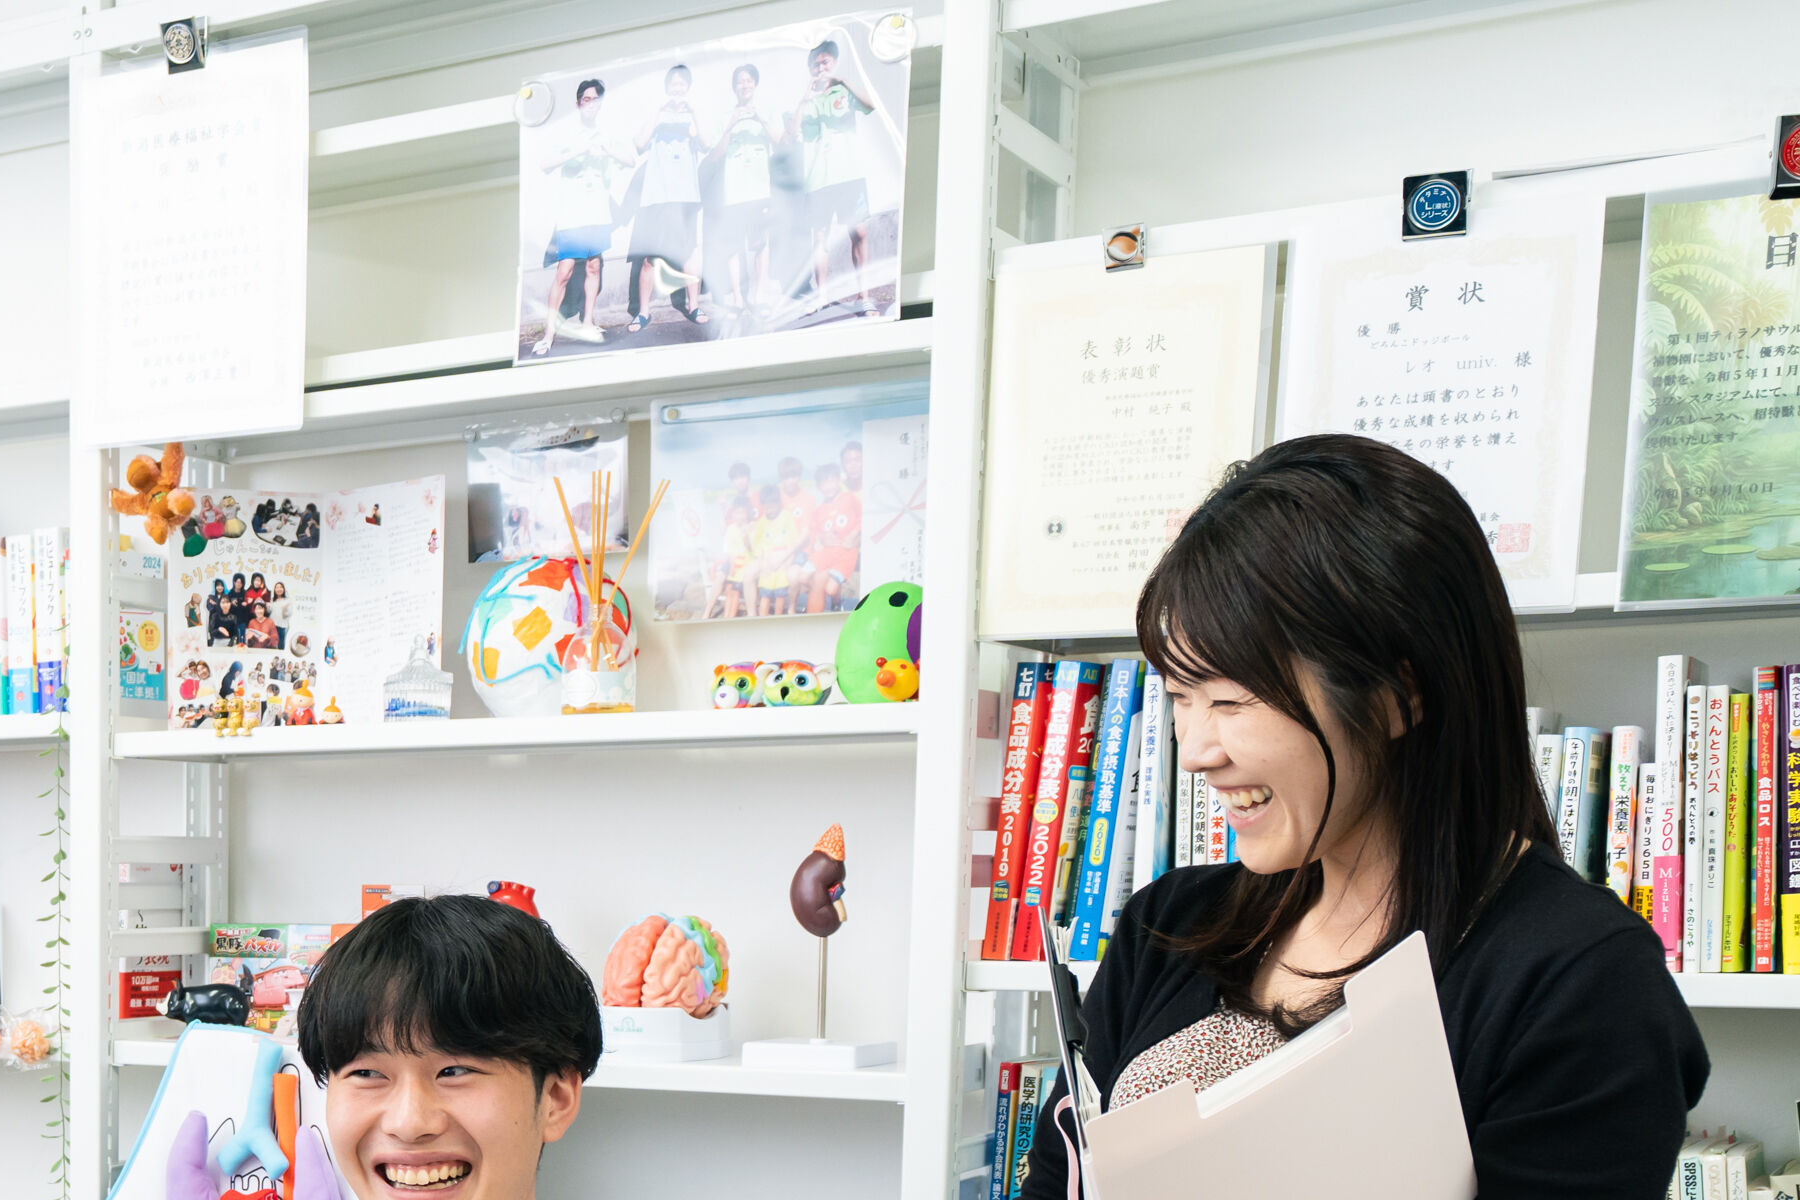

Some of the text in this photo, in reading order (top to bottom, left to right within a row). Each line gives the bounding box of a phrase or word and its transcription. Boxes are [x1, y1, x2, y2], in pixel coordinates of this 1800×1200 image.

[1420, 210, 1448, 219] シリーズ
[1405, 281, 1486, 312] 賞状
[1080, 333, 1167, 360] 表彰状
[1356, 322, 1401, 338] 優勝
[1369, 333, 1472, 350] どろんこドッジボール
[1081, 363, 1162, 385] 優秀演題賞
[1404, 351, 1532, 375] レオ univ. 様
[1356, 383, 1521, 409] あなたは頭書のとおり
[1353, 407, 1521, 433] 優秀な成績を収められ
[142, 555, 162, 569] 2024
[1145, 683, 1160, 757] スポーツ栄養学
[1037, 690, 1074, 800] 食品成分表
[1094, 670, 1131, 857] 日本人の食事摂取基準 2020
[1707, 698, 1723, 794] おべんとうバス
[998, 667, 1034, 877] 七訂 食品成分表 2019
[1194, 773, 1206, 855] のための朝食術
[1758, 776, 1772, 827] 食品ロス
[1642, 774, 1656, 880] 毎日おにぎり365日
[1662, 807, 1674, 851] 500
[1028, 826, 1050, 885] 2022
[1707, 847, 1716, 889] 真珠まりこ
[1659, 867, 1673, 923] Mizuki
[215, 936, 283, 953] 黒豚パズル
[1013, 1076, 1037, 1194] 医学的研究のデザイン
